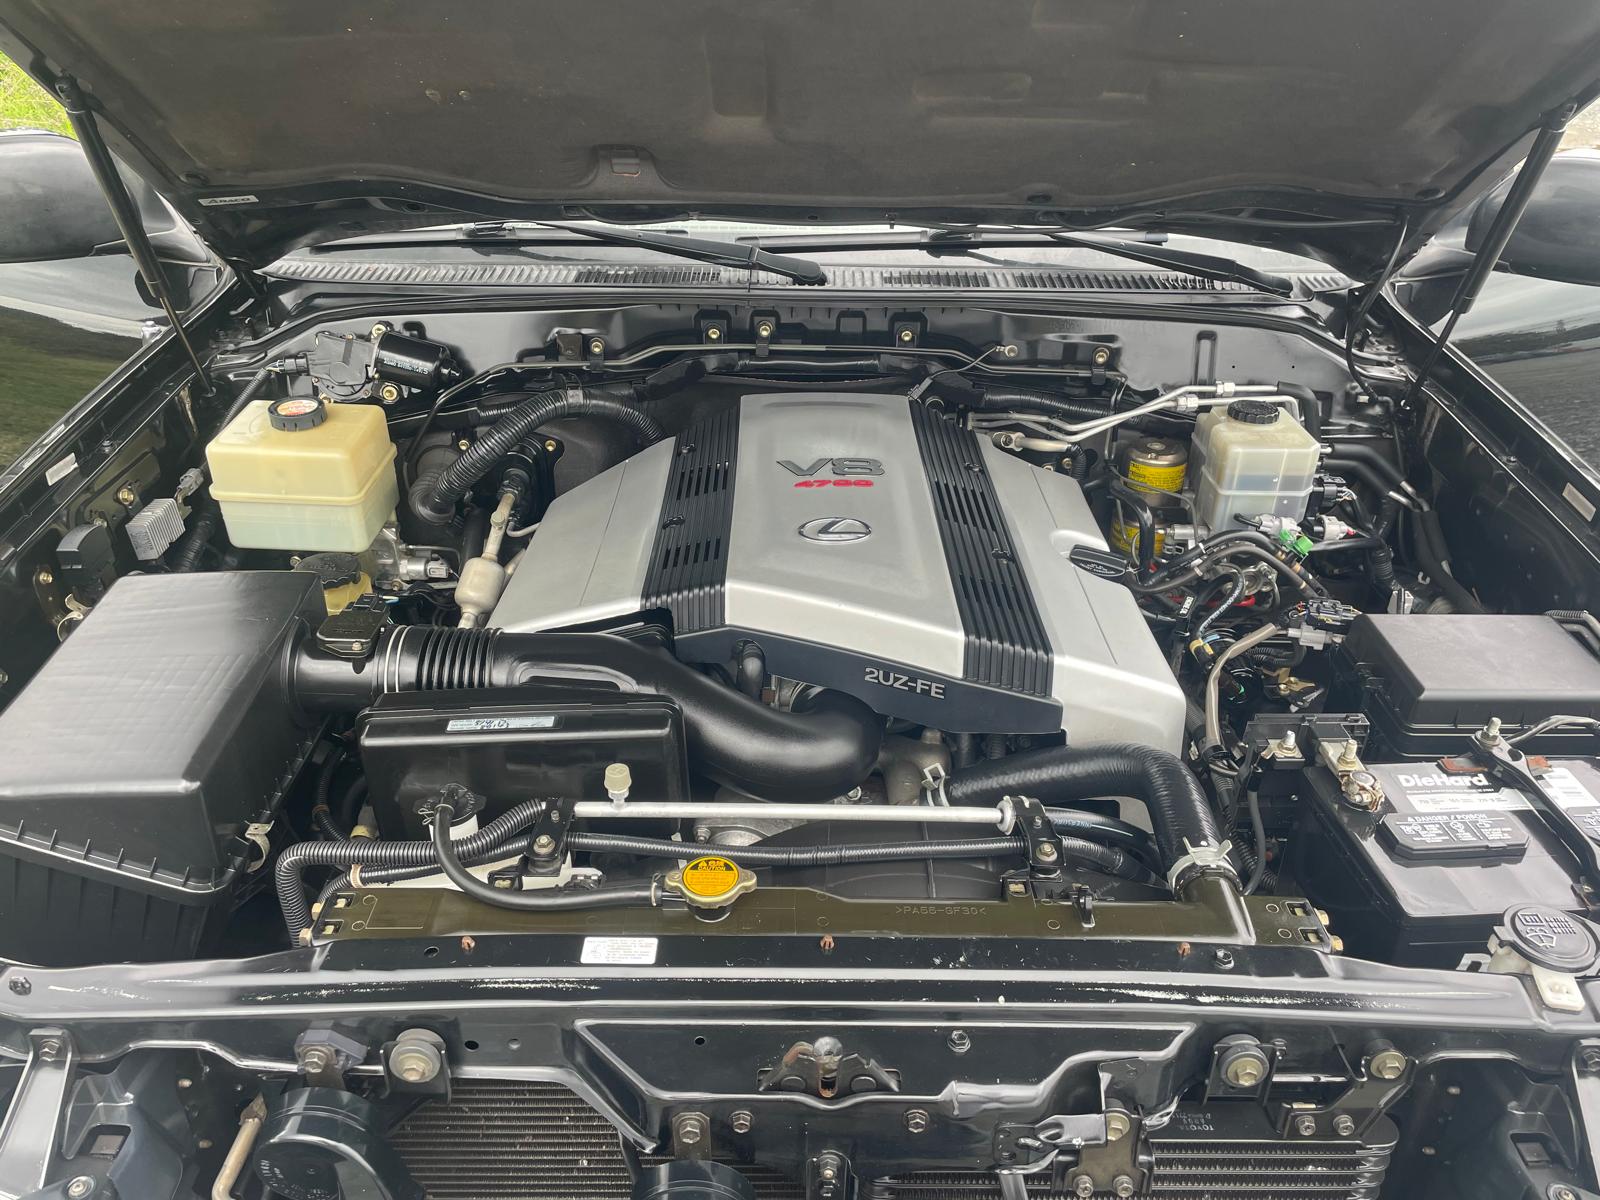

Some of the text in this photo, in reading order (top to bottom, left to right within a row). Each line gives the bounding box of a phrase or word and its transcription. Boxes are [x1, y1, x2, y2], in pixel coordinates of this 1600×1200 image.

[776, 457, 885, 476] V8
[864, 667, 945, 699] 2UZ-FE
[1397, 773, 1489, 787] DieHard
